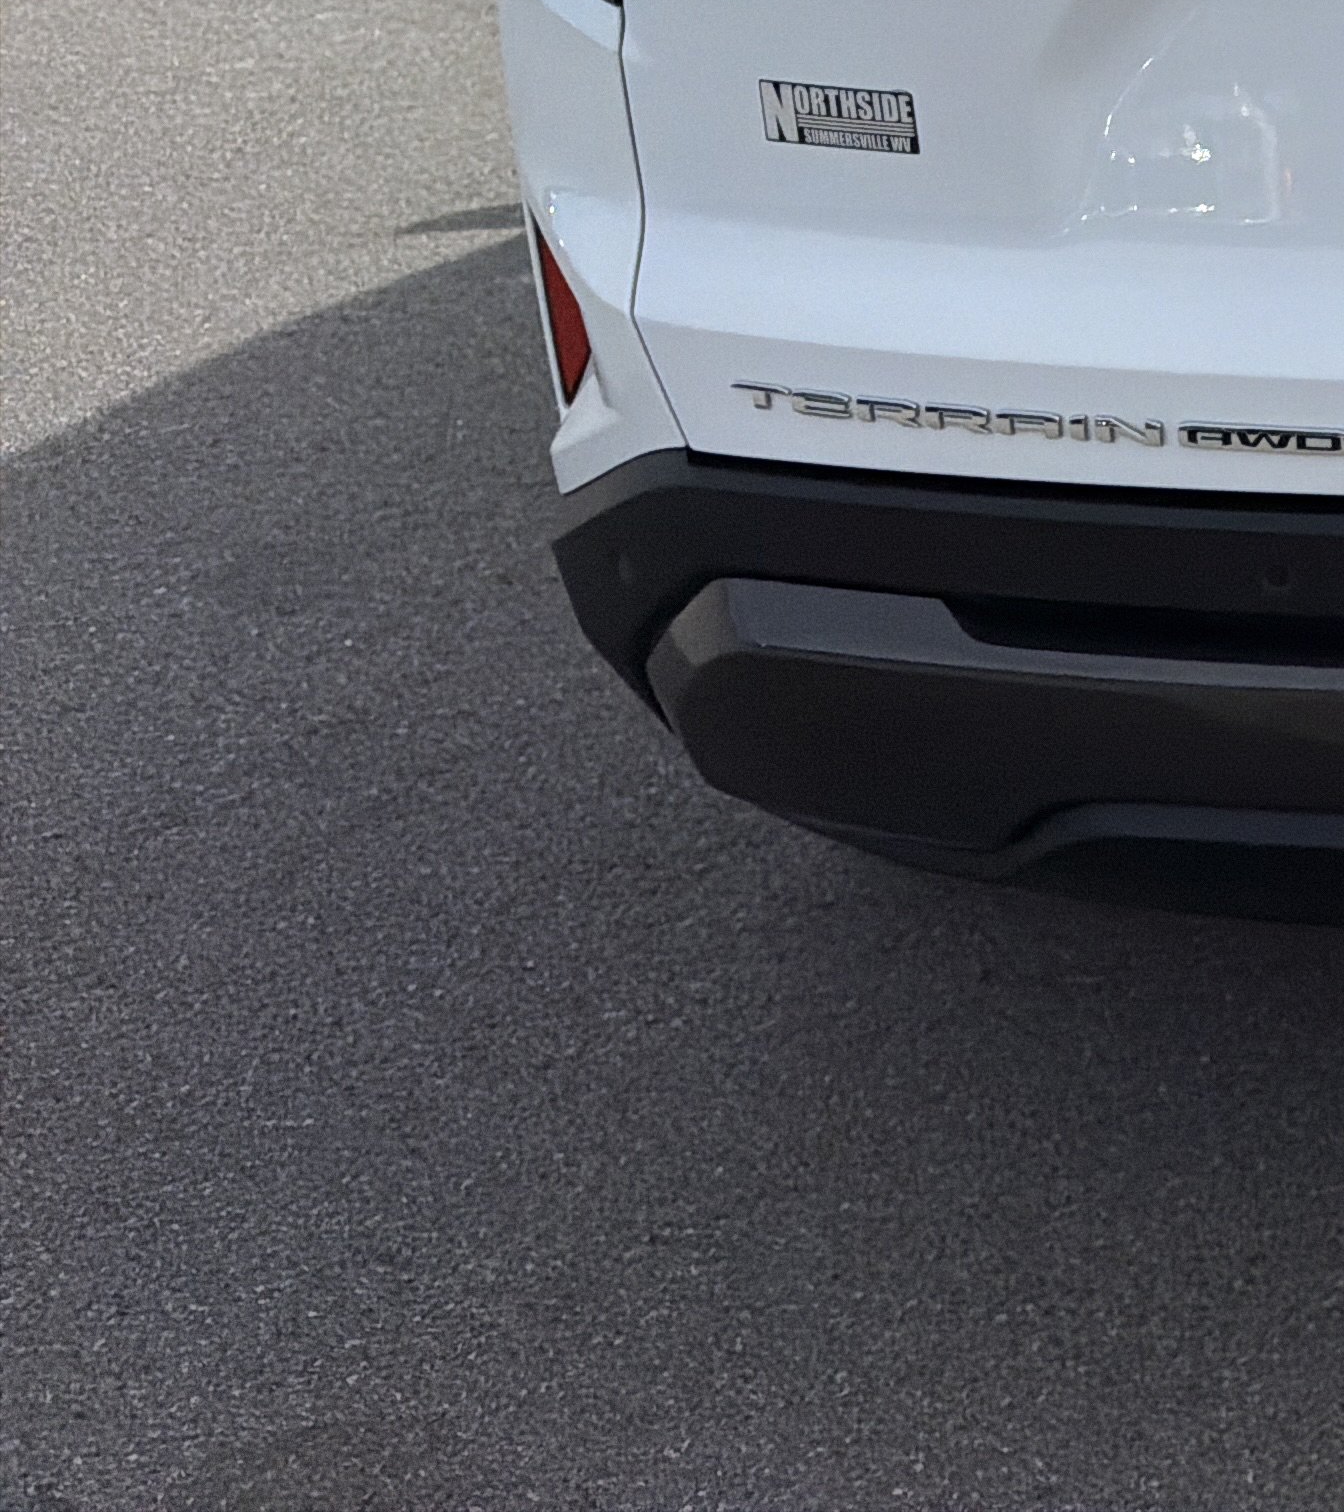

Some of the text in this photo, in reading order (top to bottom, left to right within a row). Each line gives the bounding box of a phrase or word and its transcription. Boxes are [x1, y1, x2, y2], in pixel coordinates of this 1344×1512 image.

[759, 81, 914, 143] NORTHSIDE
[804, 128, 911, 153] SUMMERSVILLE WV
[730, 379, 1166, 447] TERRAIN
